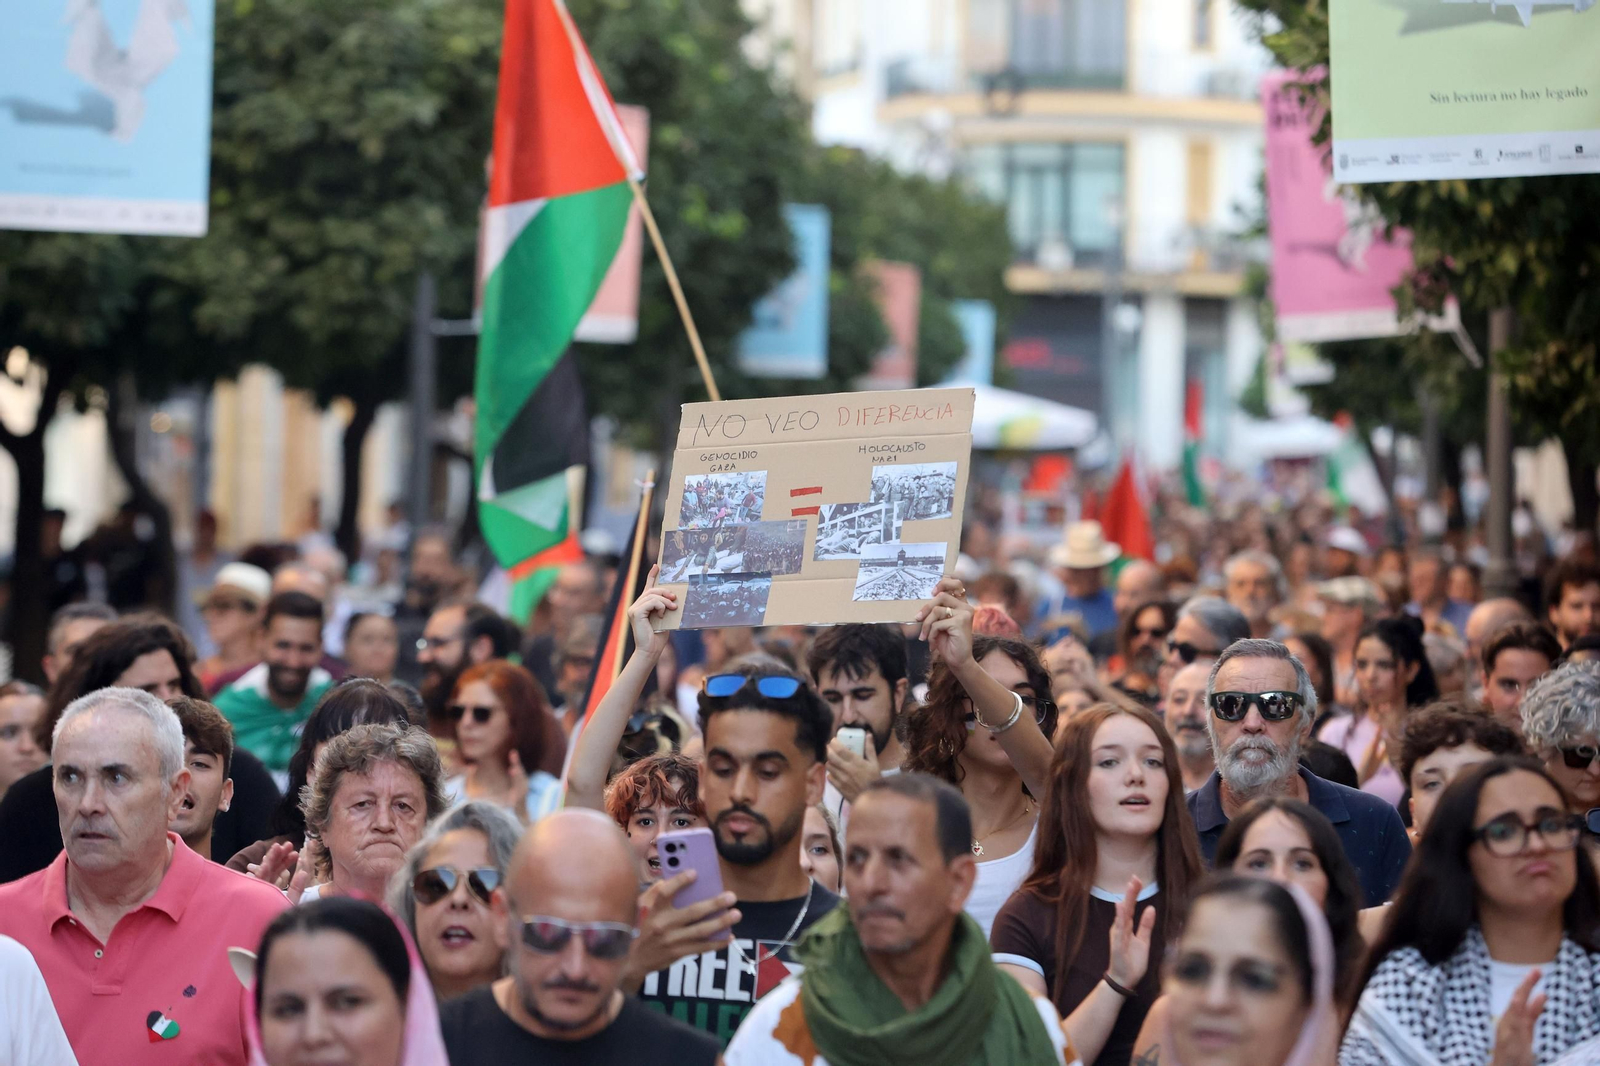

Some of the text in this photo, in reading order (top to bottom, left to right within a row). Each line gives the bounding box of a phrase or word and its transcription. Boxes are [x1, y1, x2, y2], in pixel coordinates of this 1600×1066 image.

[1429, 86, 1588, 104] Sin lectura no hay legado
[692, 402, 954, 447] NO VEO DIFERENCIA
[858, 441, 926, 455] HOLOCAUSTO
[699, 450, 759, 462] GENOCIDIO
[871, 454, 897, 463] NAZI
[709, 462, 737, 473] GAZA
